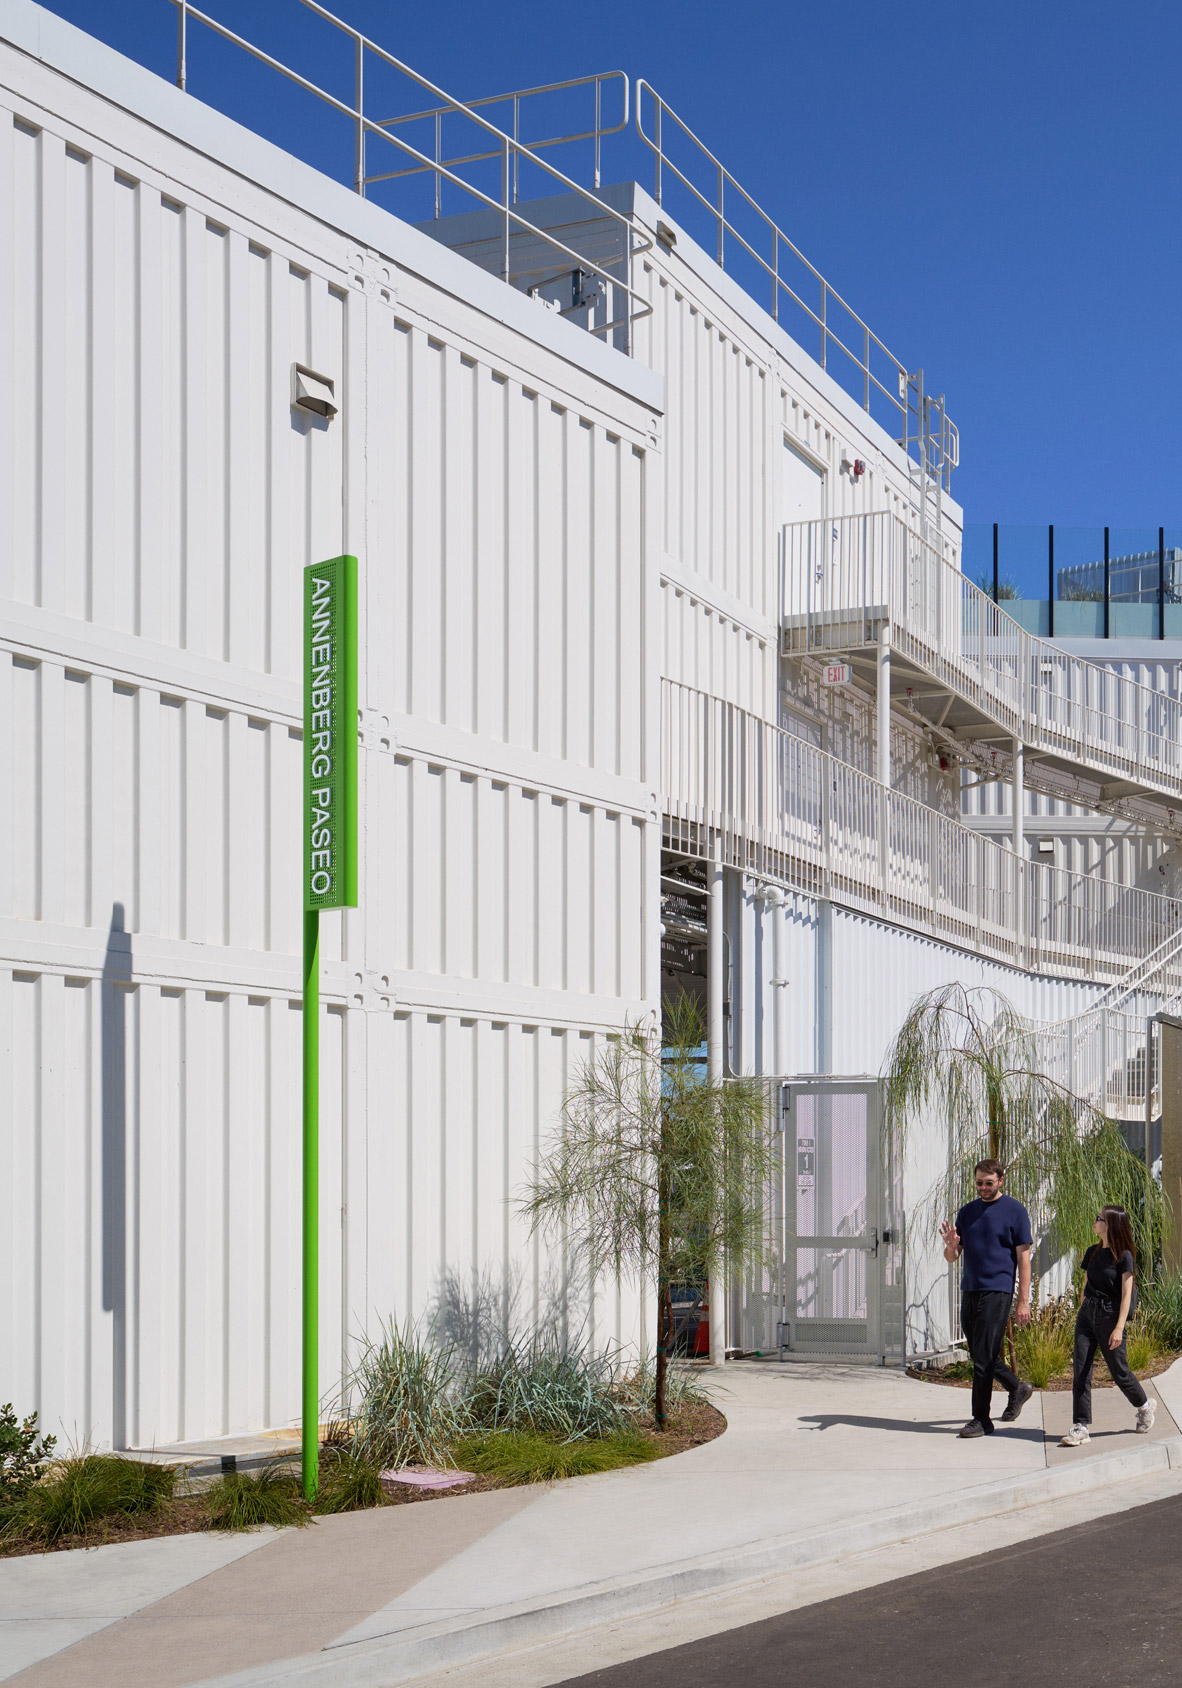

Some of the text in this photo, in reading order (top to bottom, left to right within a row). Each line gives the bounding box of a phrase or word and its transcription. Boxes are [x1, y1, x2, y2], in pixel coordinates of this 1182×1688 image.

[312, 577, 332, 895] ANNENBERG PASEO
[828, 665, 846, 682] EXIT
